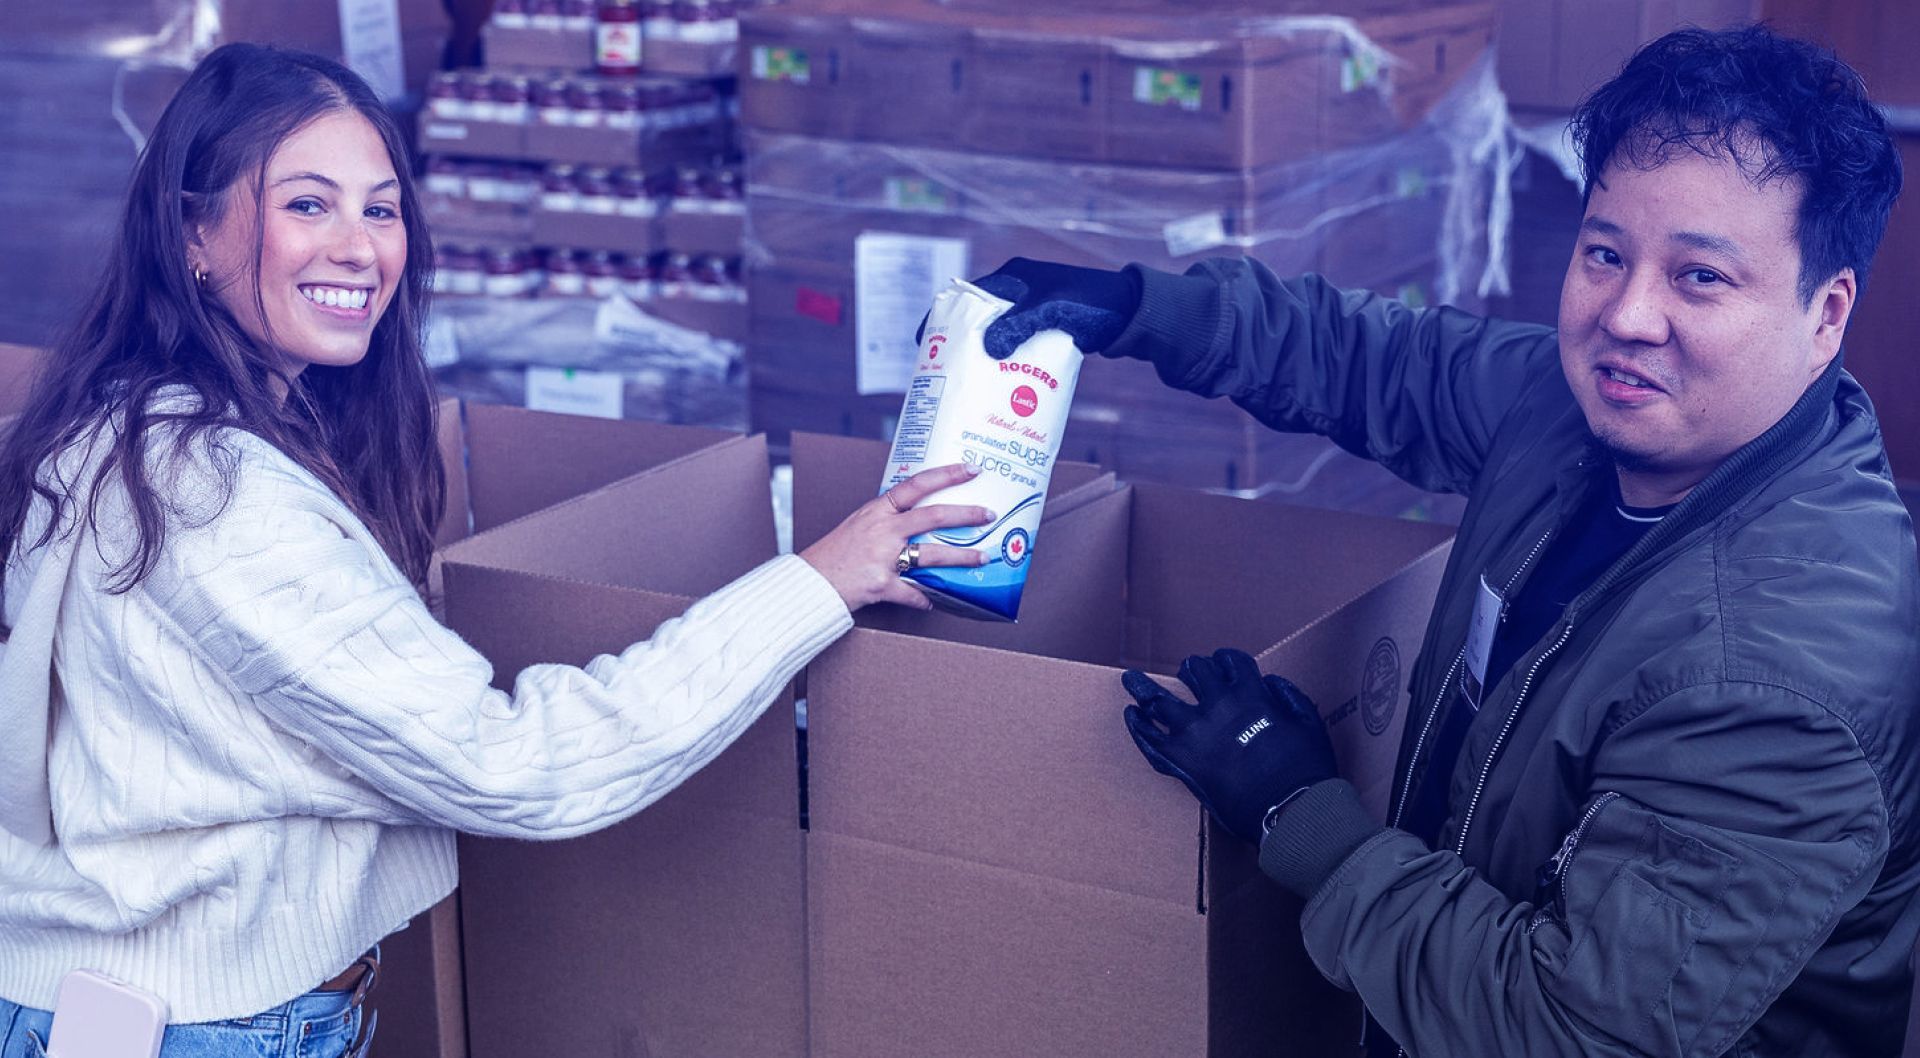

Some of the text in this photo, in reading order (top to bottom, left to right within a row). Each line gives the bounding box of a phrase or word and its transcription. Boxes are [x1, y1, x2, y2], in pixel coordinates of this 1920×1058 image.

[999, 362, 1058, 389] ROGERS
[1012, 392, 1035, 409] Lantic
[961, 430, 1007, 451] granulated
[961, 449, 1012, 477] sucre
[1238, 718, 1270, 744] ULINE
